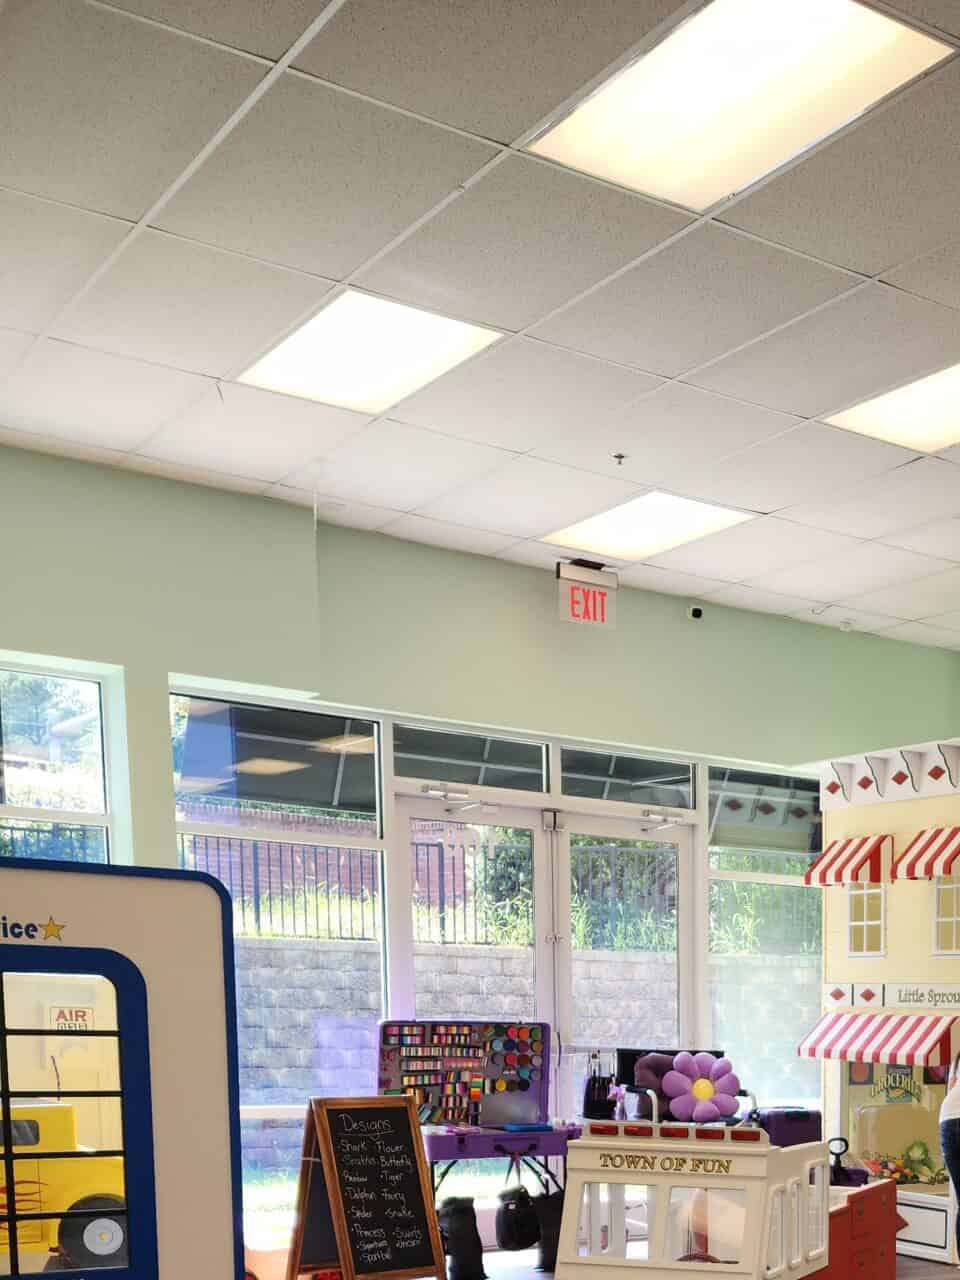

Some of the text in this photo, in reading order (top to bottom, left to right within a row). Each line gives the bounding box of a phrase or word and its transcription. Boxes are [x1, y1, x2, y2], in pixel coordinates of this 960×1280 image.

[569, 584, 607, 623] EXIT
[897, 988, 925, 1003] Little
[56, 1009, 87, 1022] AIR
[338, 1113, 393, 1141] Designs
[600, 1153, 732, 1174] TOWN OF FUN
